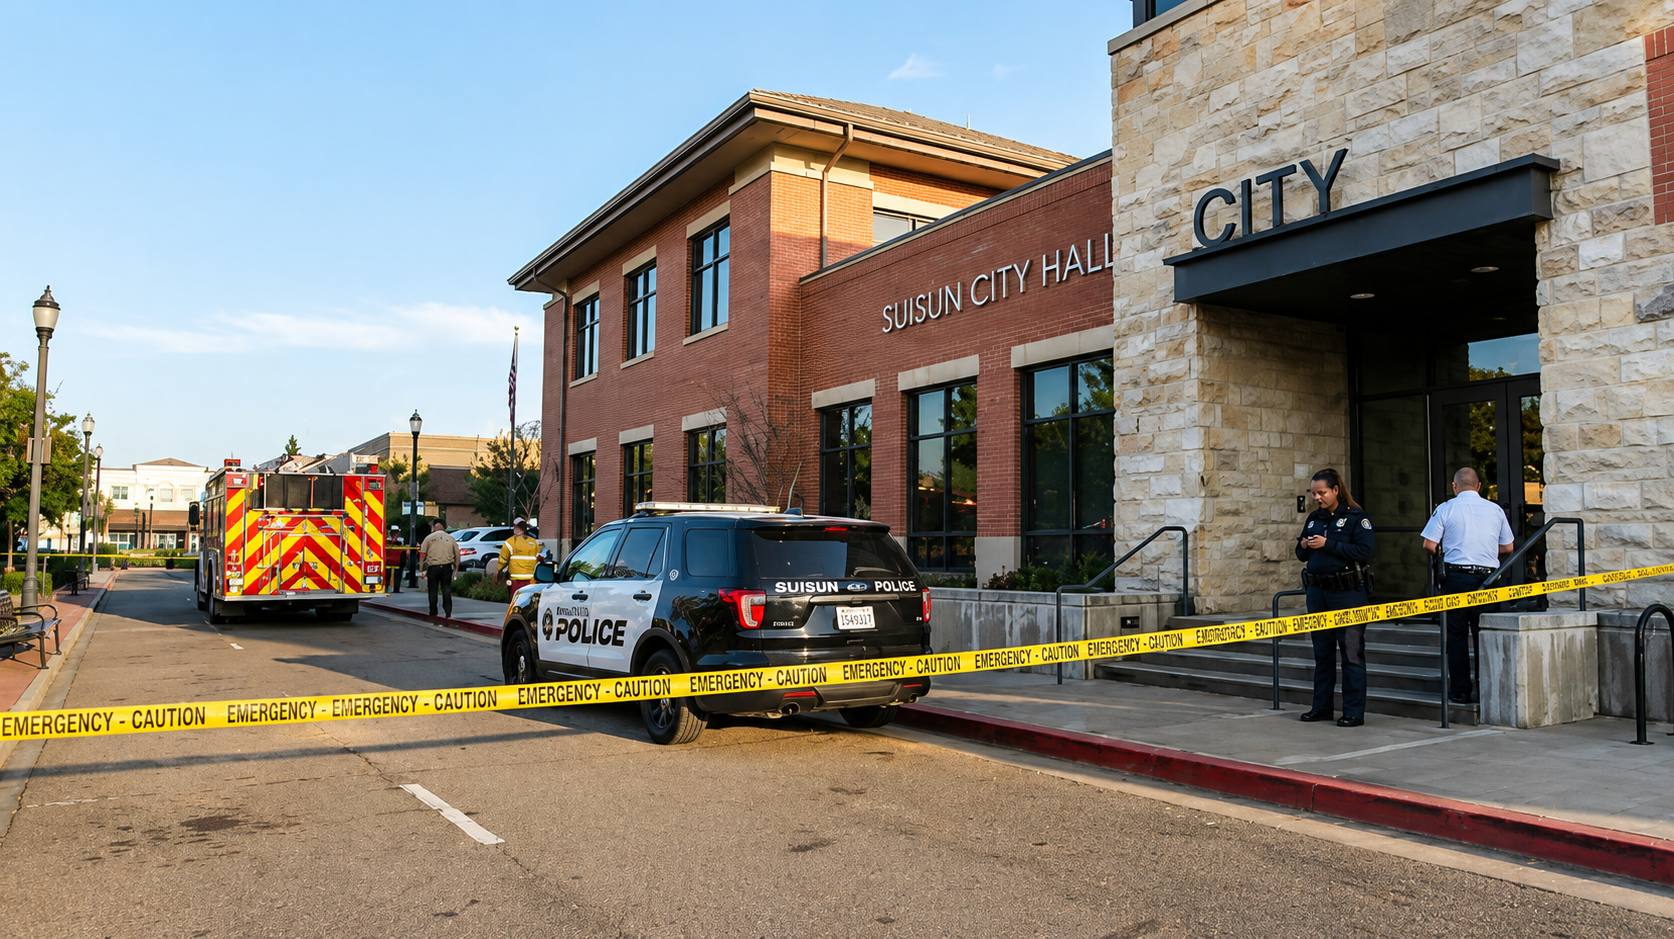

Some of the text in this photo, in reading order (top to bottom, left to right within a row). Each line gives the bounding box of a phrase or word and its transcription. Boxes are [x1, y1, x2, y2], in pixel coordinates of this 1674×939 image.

[1193, 148, 1348, 247] CITY
[882, 233, 1114, 333] SUISUN CITY HALL
[555, 617, 628, 647] POLICE
[774, 581, 839, 593] SUISUN
[874, 580, 917, 592] POLICE
[2, 711, 114, 737] EMERGENCY
[132, 706, 206, 729] CAUTION
[227, 700, 318, 724] EMERGENCY
[332, 694, 419, 717] EMERGENCY
[434, 689, 497, 711] CAUTION
[517, 683, 601, 706] EMERGENCY
[614, 678, 671, 698] CAUTION
[690, 671, 764, 693] EMERGENCY
[776, 666, 827, 686] CAUTION
[842, 660, 906, 681] EMERGENCY
[916, 655, 961, 674] CAUTION
[975, 649, 1032, 669] EMERGENCY
[1041, 644, 1080, 662] CAUTION
